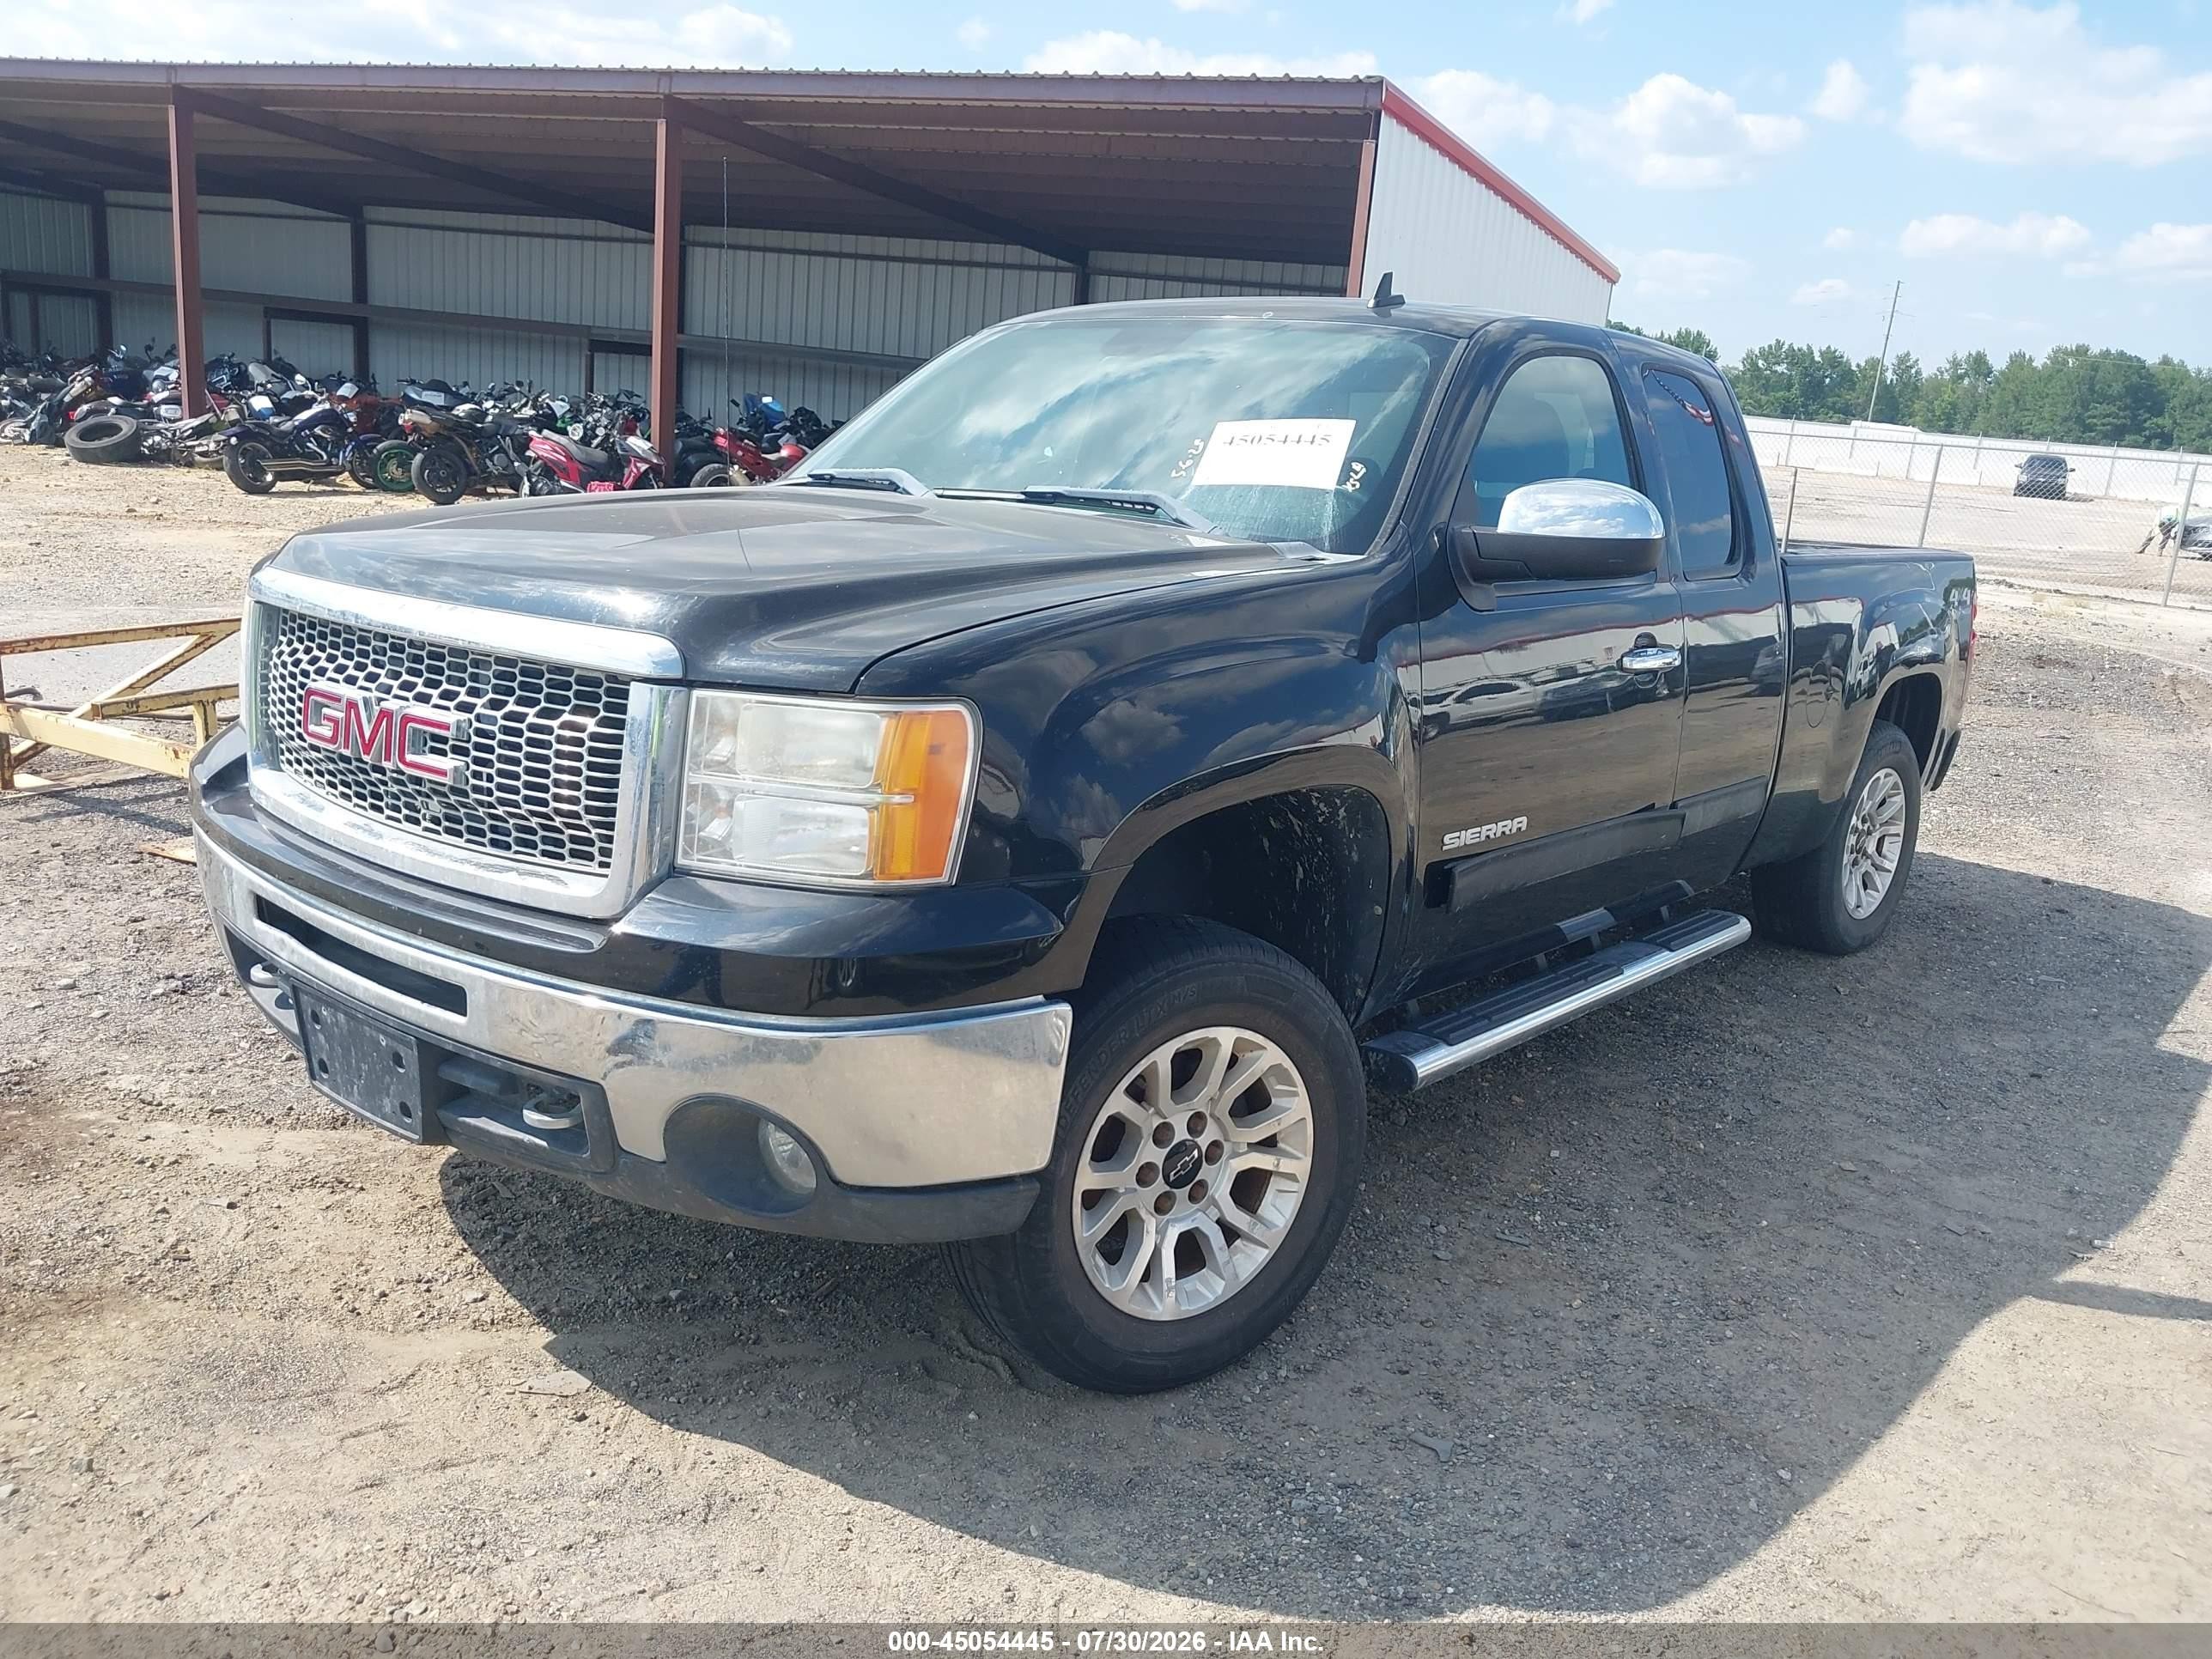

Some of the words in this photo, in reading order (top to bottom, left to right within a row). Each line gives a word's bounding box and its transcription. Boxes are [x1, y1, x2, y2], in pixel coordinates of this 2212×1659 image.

[1222, 433, 1333, 447] 45054445
[301, 682, 470, 785] GMC
[1442, 816, 1528, 851] SIERRA
